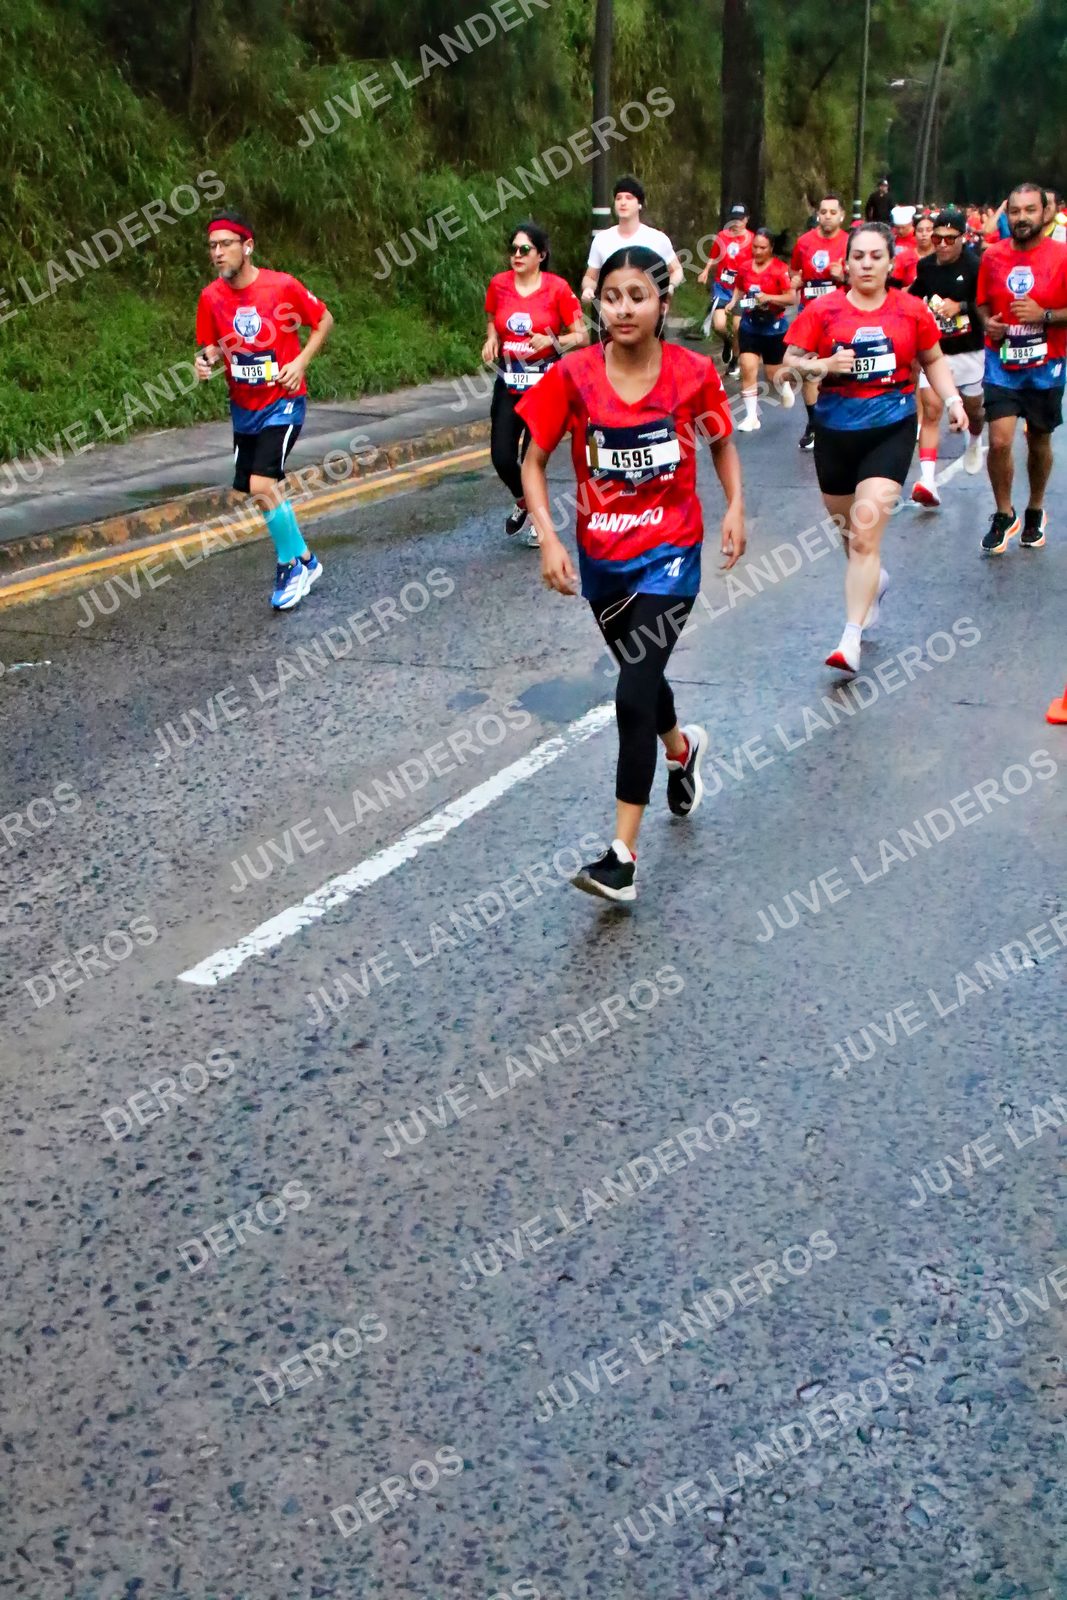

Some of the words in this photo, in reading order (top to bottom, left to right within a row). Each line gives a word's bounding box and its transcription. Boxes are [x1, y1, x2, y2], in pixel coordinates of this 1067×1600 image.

[1012, 347, 1034, 359] 3842
[241, 366, 263, 377] 4736
[850, 358, 876, 373] 637
[513, 374, 529, 384] 5121
[611, 448, 654, 469] 4595
[587, 506, 664, 533] SANTGO
